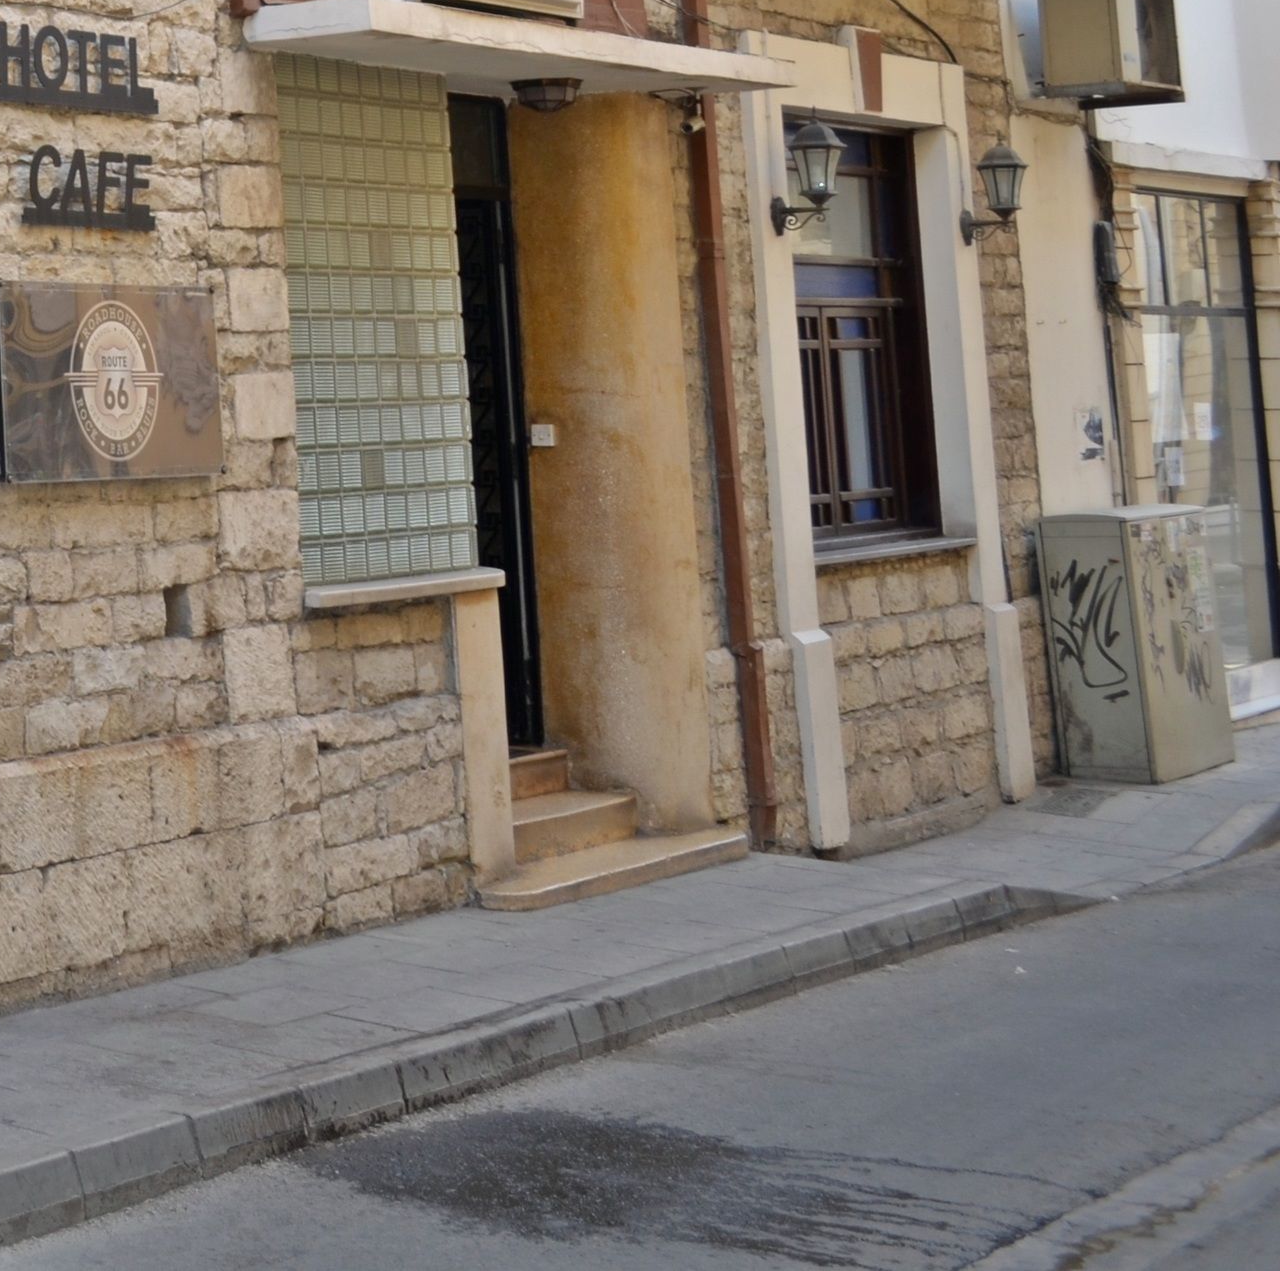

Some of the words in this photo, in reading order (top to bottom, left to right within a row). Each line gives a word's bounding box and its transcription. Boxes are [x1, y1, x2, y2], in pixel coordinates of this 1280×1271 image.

[28, 144, 154, 218] CAFE
[82, 306, 143, 341] ROADHOUSE
[101, 355, 128, 368] ROUTE
[103, 377, 130, 410] 66
[75, 398, 98, 442] ROCK
[109, 442, 129, 455] BAR
